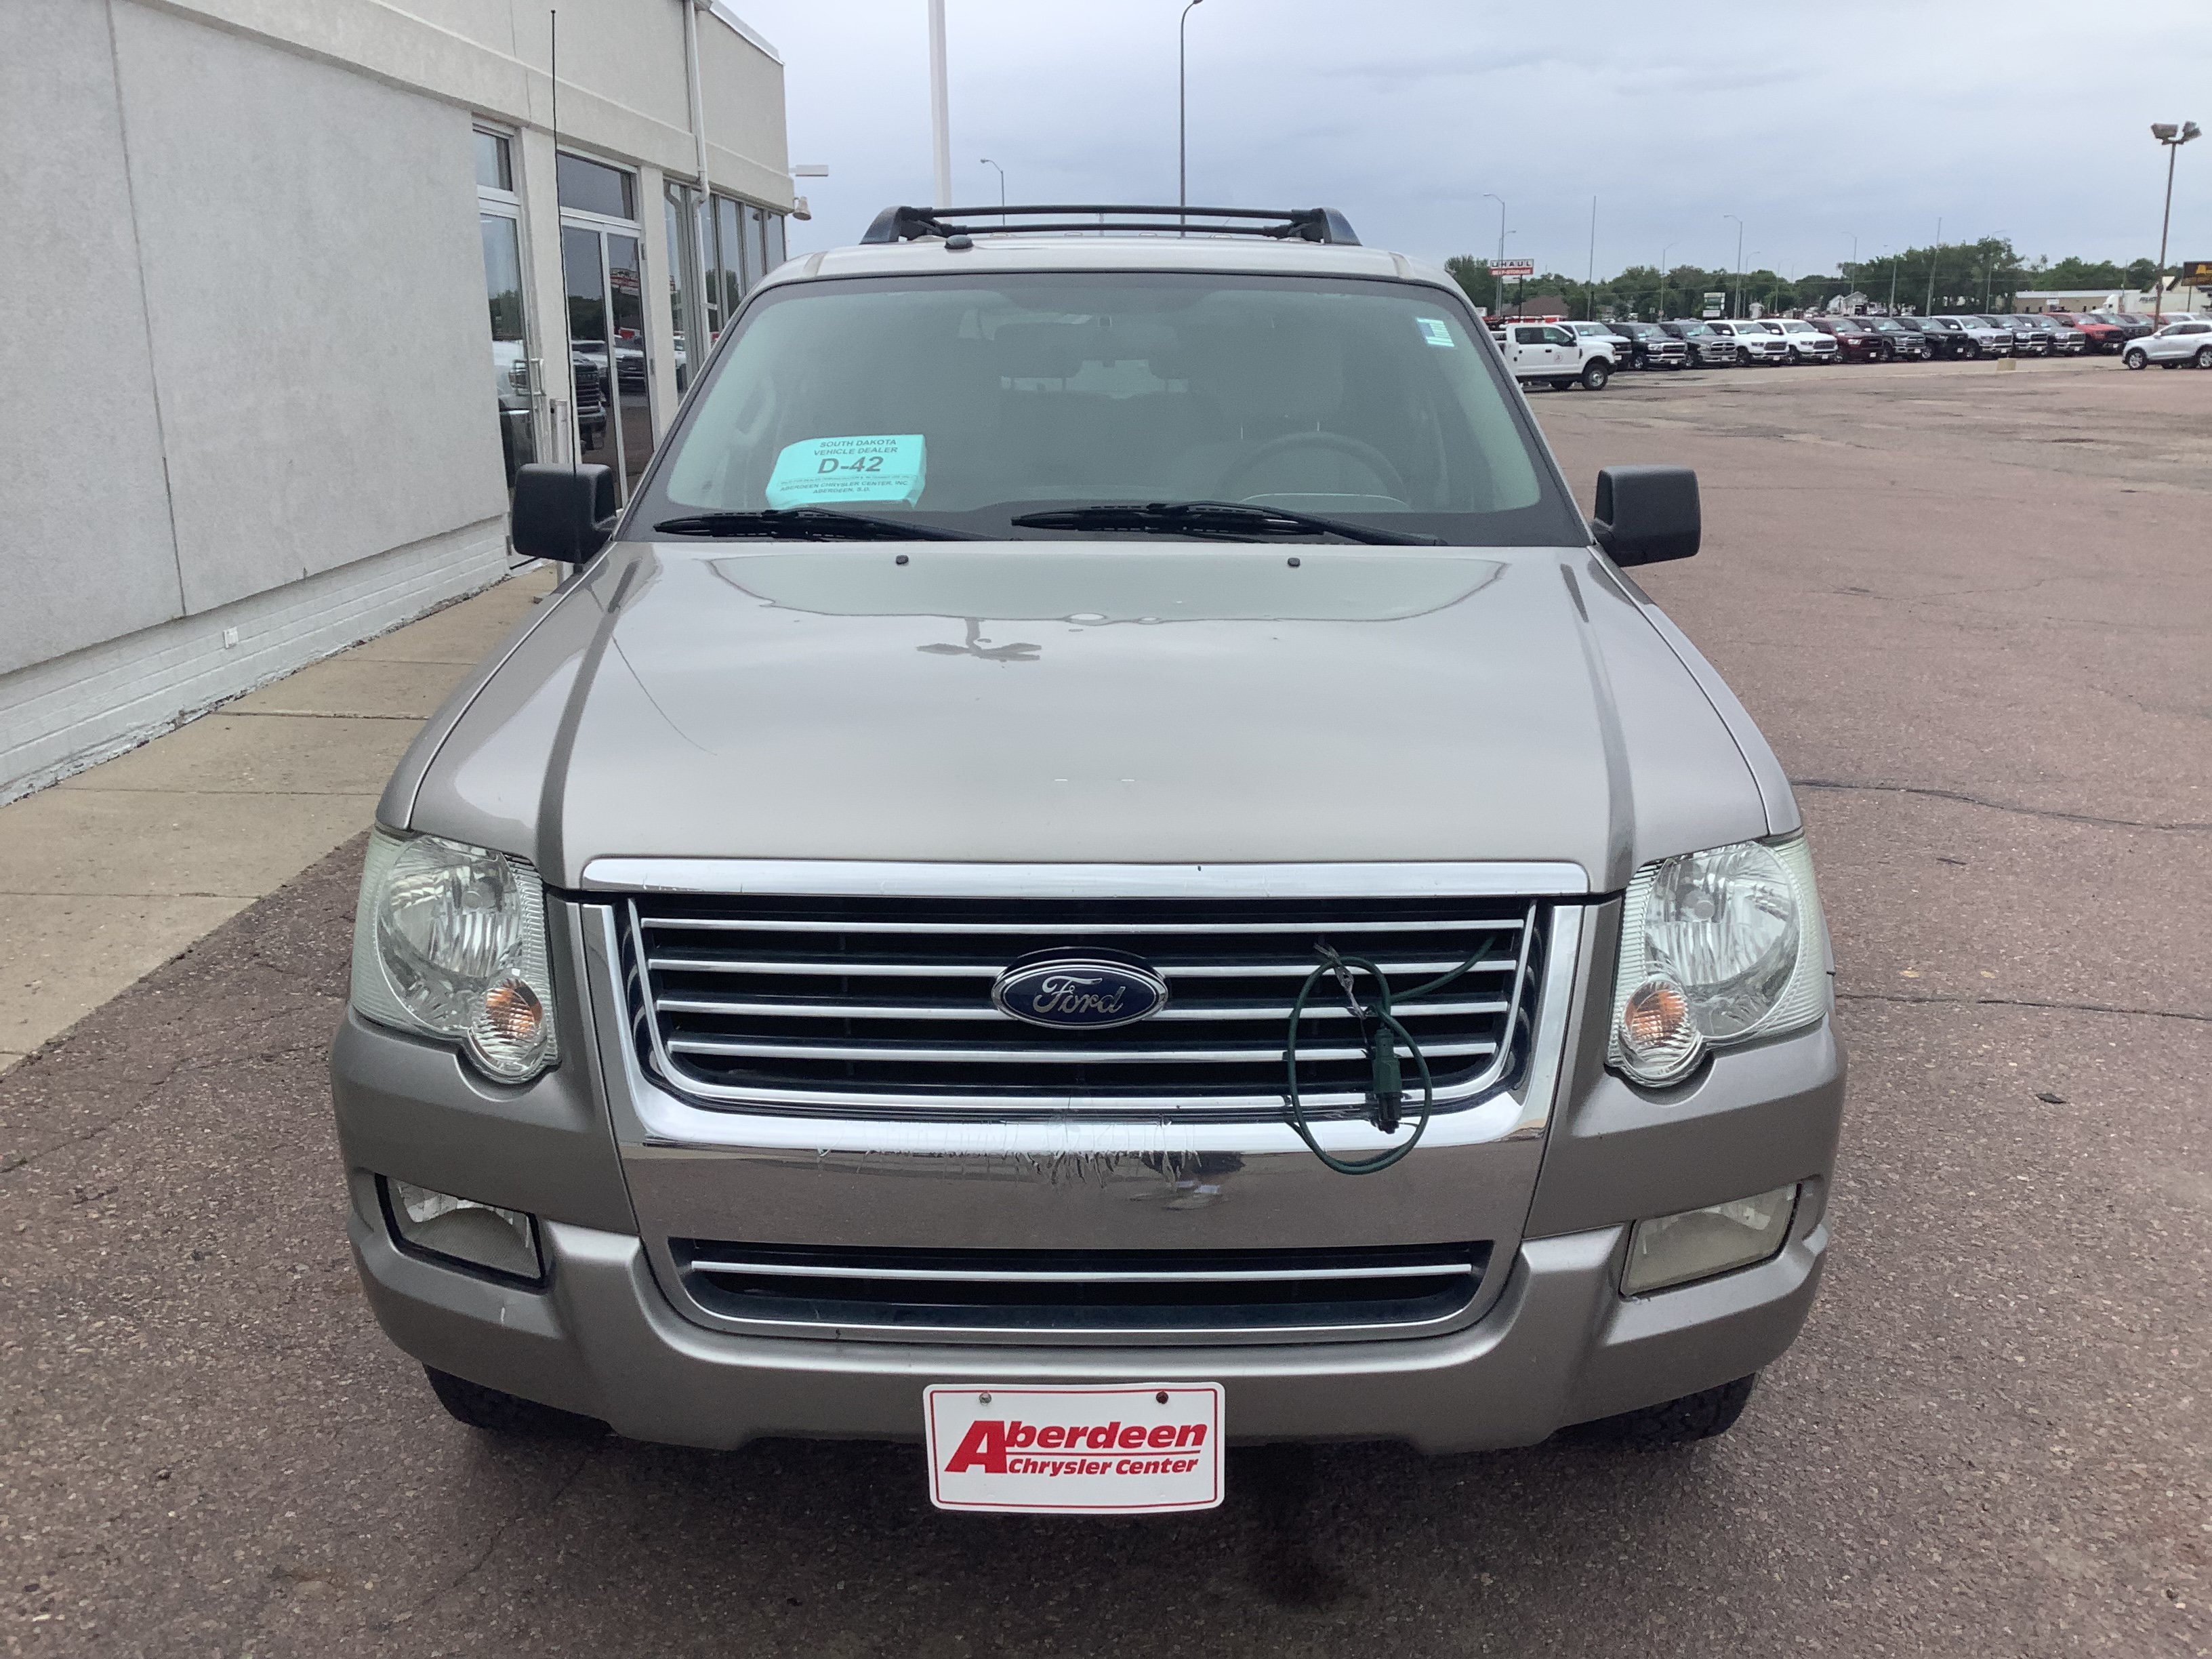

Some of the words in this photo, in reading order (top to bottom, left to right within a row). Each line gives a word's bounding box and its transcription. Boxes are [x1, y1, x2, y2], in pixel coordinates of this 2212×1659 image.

[814, 448, 855, 456] VEHICLE
[817, 456, 884, 474] D-42
[780, 483, 819, 491] ABERDEEN
[1032, 975, 1126, 1013] Ford
[944, 1420, 1208, 1474] Aberdeen
[1008, 1458, 1113, 1477] Chrysler
[1115, 1458, 1199, 1475] Center
